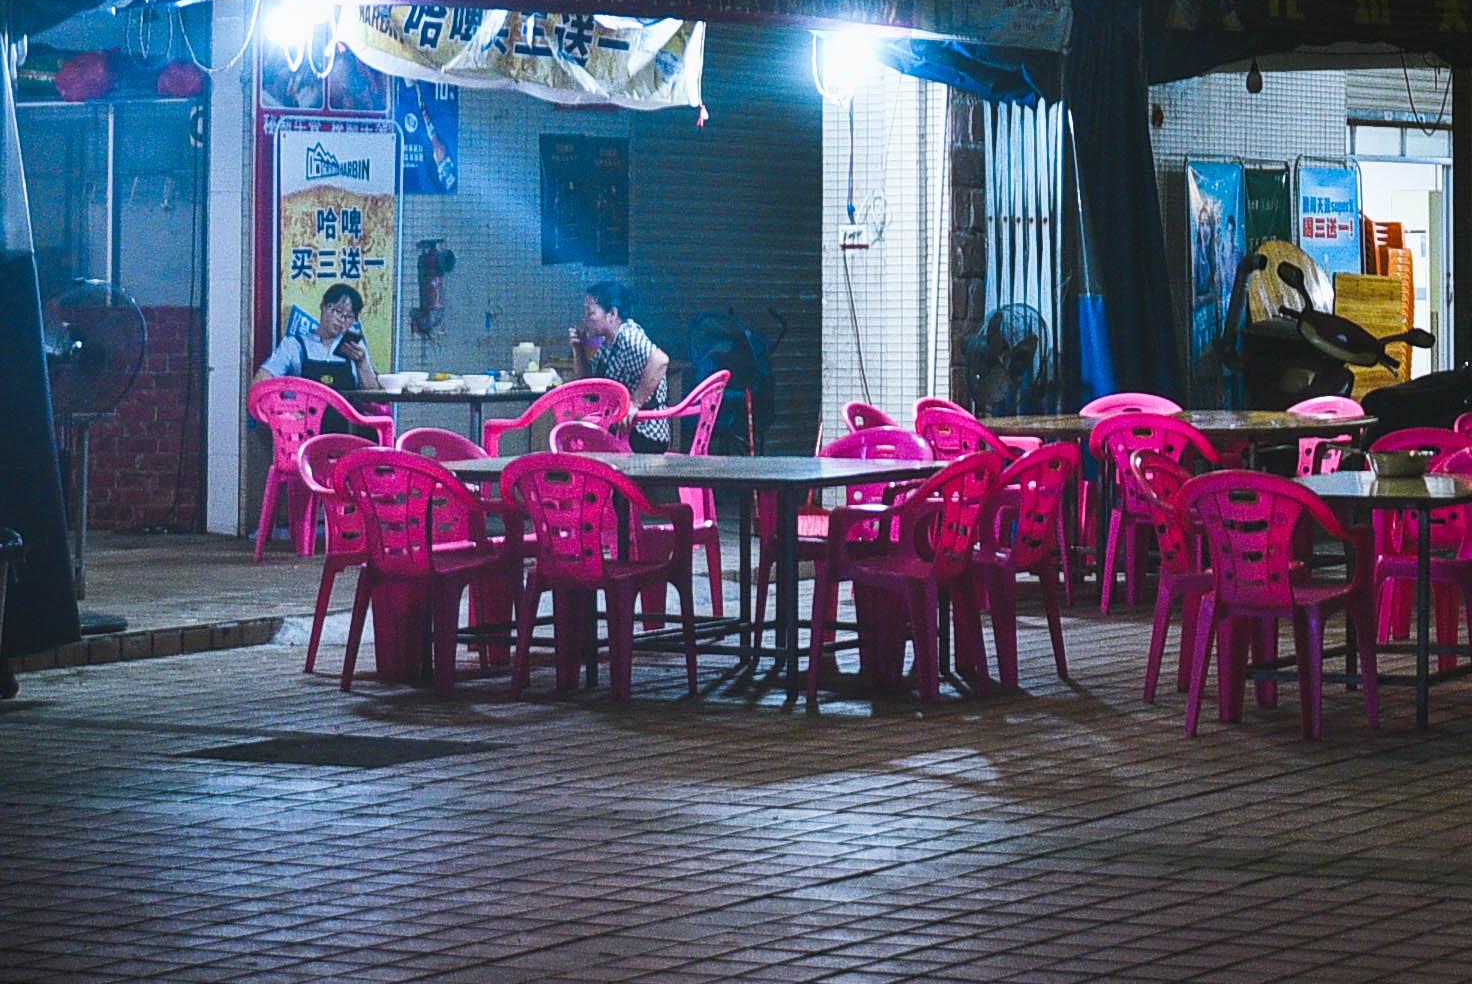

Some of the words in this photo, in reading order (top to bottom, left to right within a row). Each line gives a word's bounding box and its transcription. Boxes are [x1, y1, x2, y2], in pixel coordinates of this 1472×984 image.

[317, 208, 362, 240] 哈啤
[291, 248, 385, 280] 买三送一
